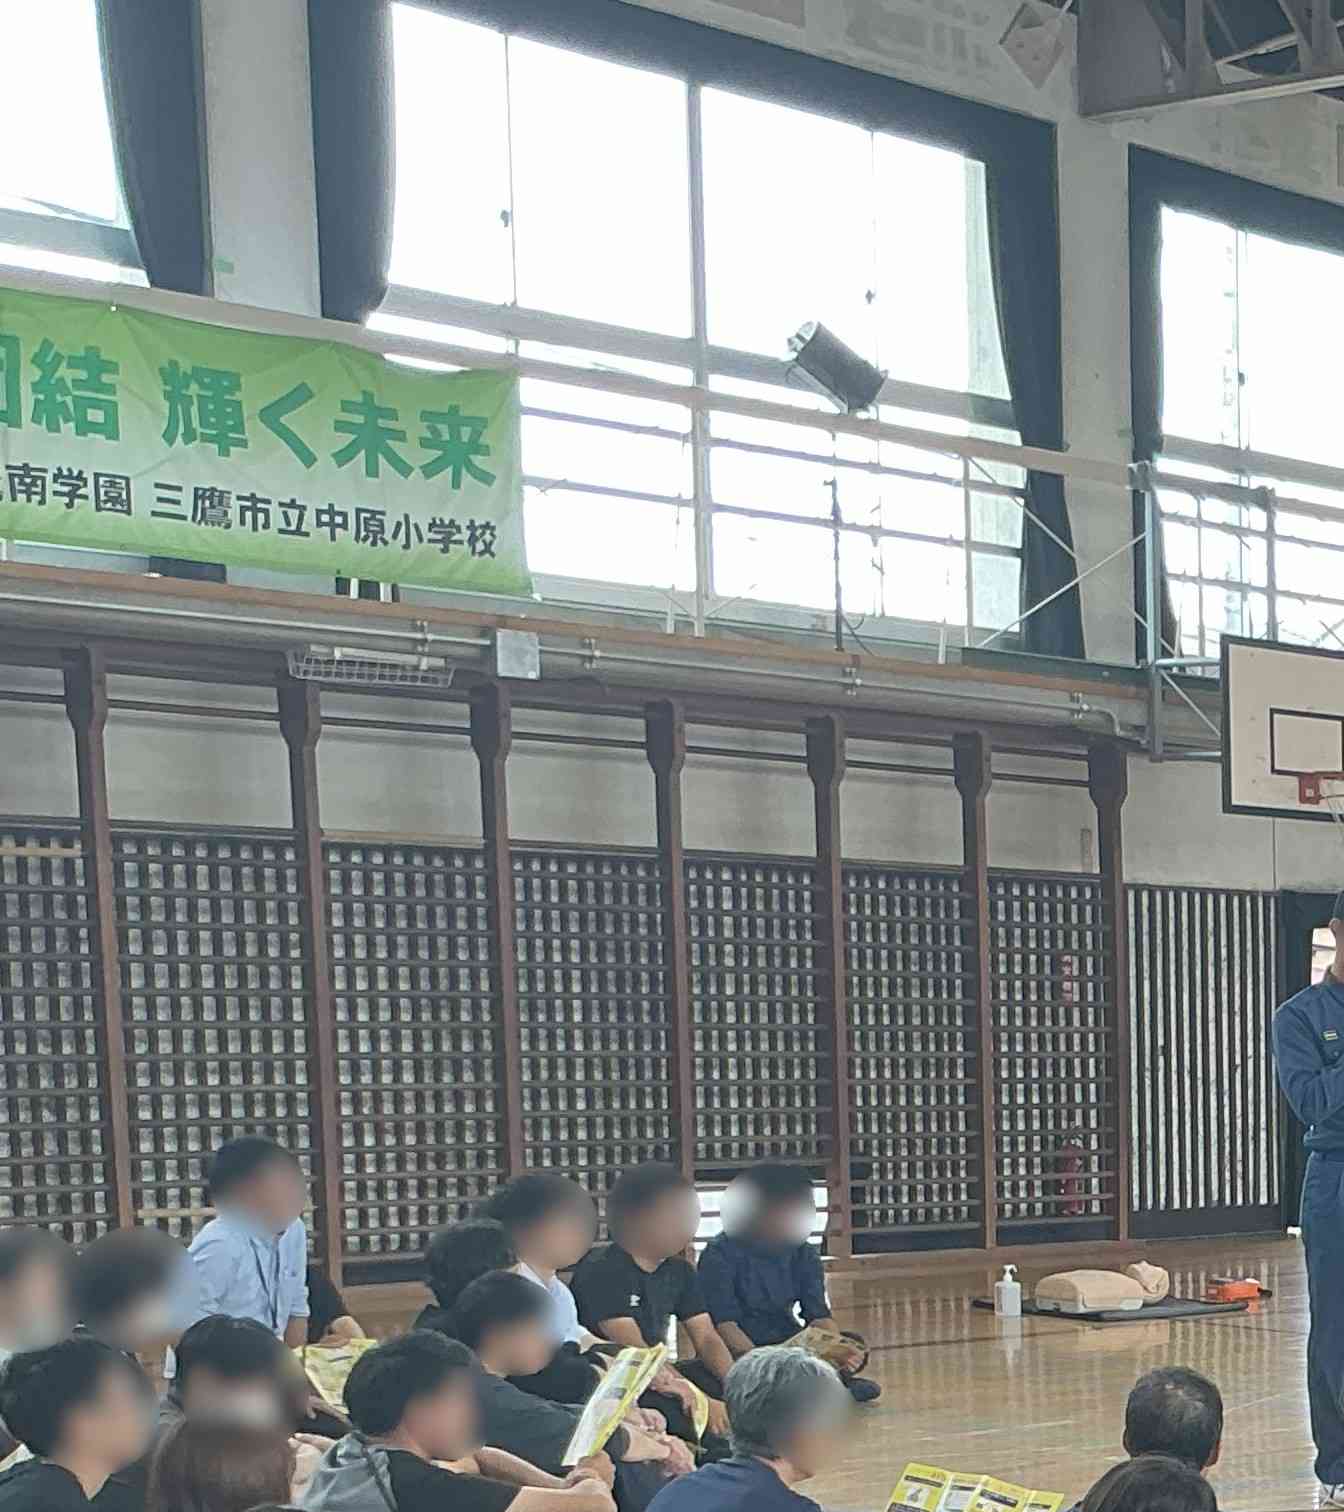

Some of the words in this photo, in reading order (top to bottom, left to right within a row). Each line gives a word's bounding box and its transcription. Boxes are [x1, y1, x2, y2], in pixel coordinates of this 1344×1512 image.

[0, 332, 121, 442] 結
[158, 359, 498, 490] 輝く未来
[150, 481, 498, 558] 三鷹市立中原小学校
